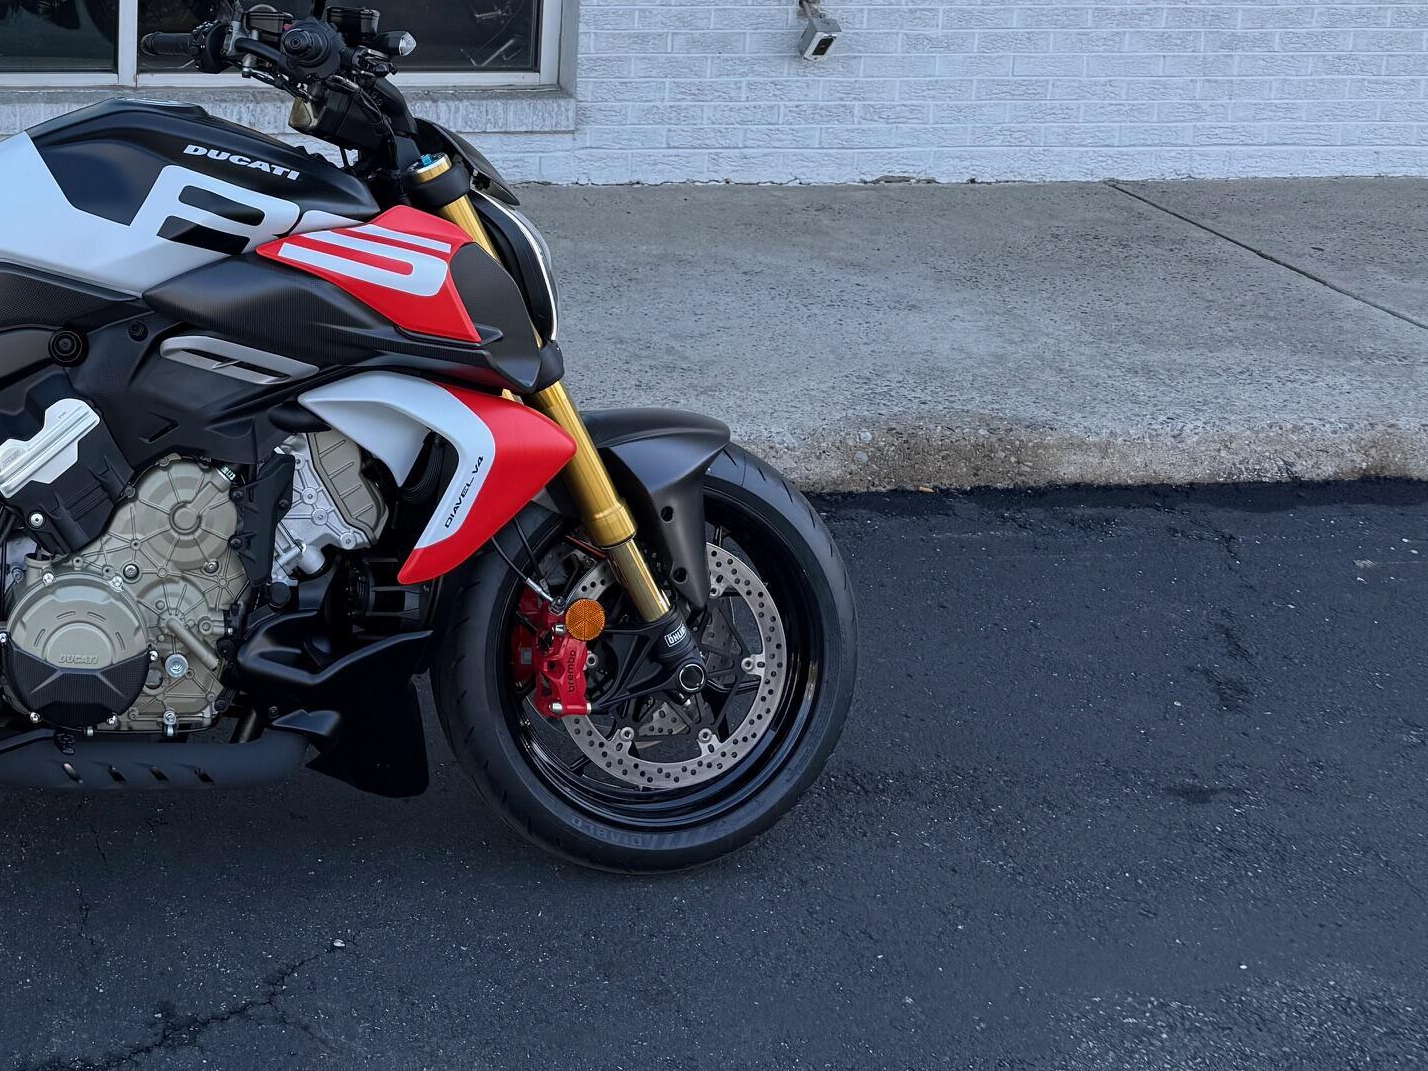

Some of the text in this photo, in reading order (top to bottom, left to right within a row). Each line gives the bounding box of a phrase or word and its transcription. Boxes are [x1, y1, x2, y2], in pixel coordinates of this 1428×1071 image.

[183, 144, 301, 181] DUCATI
[444, 455, 484, 528] DIAVEL V4
[59, 654, 99, 665] DUCATI
[566, 650, 576, 693] brembo
